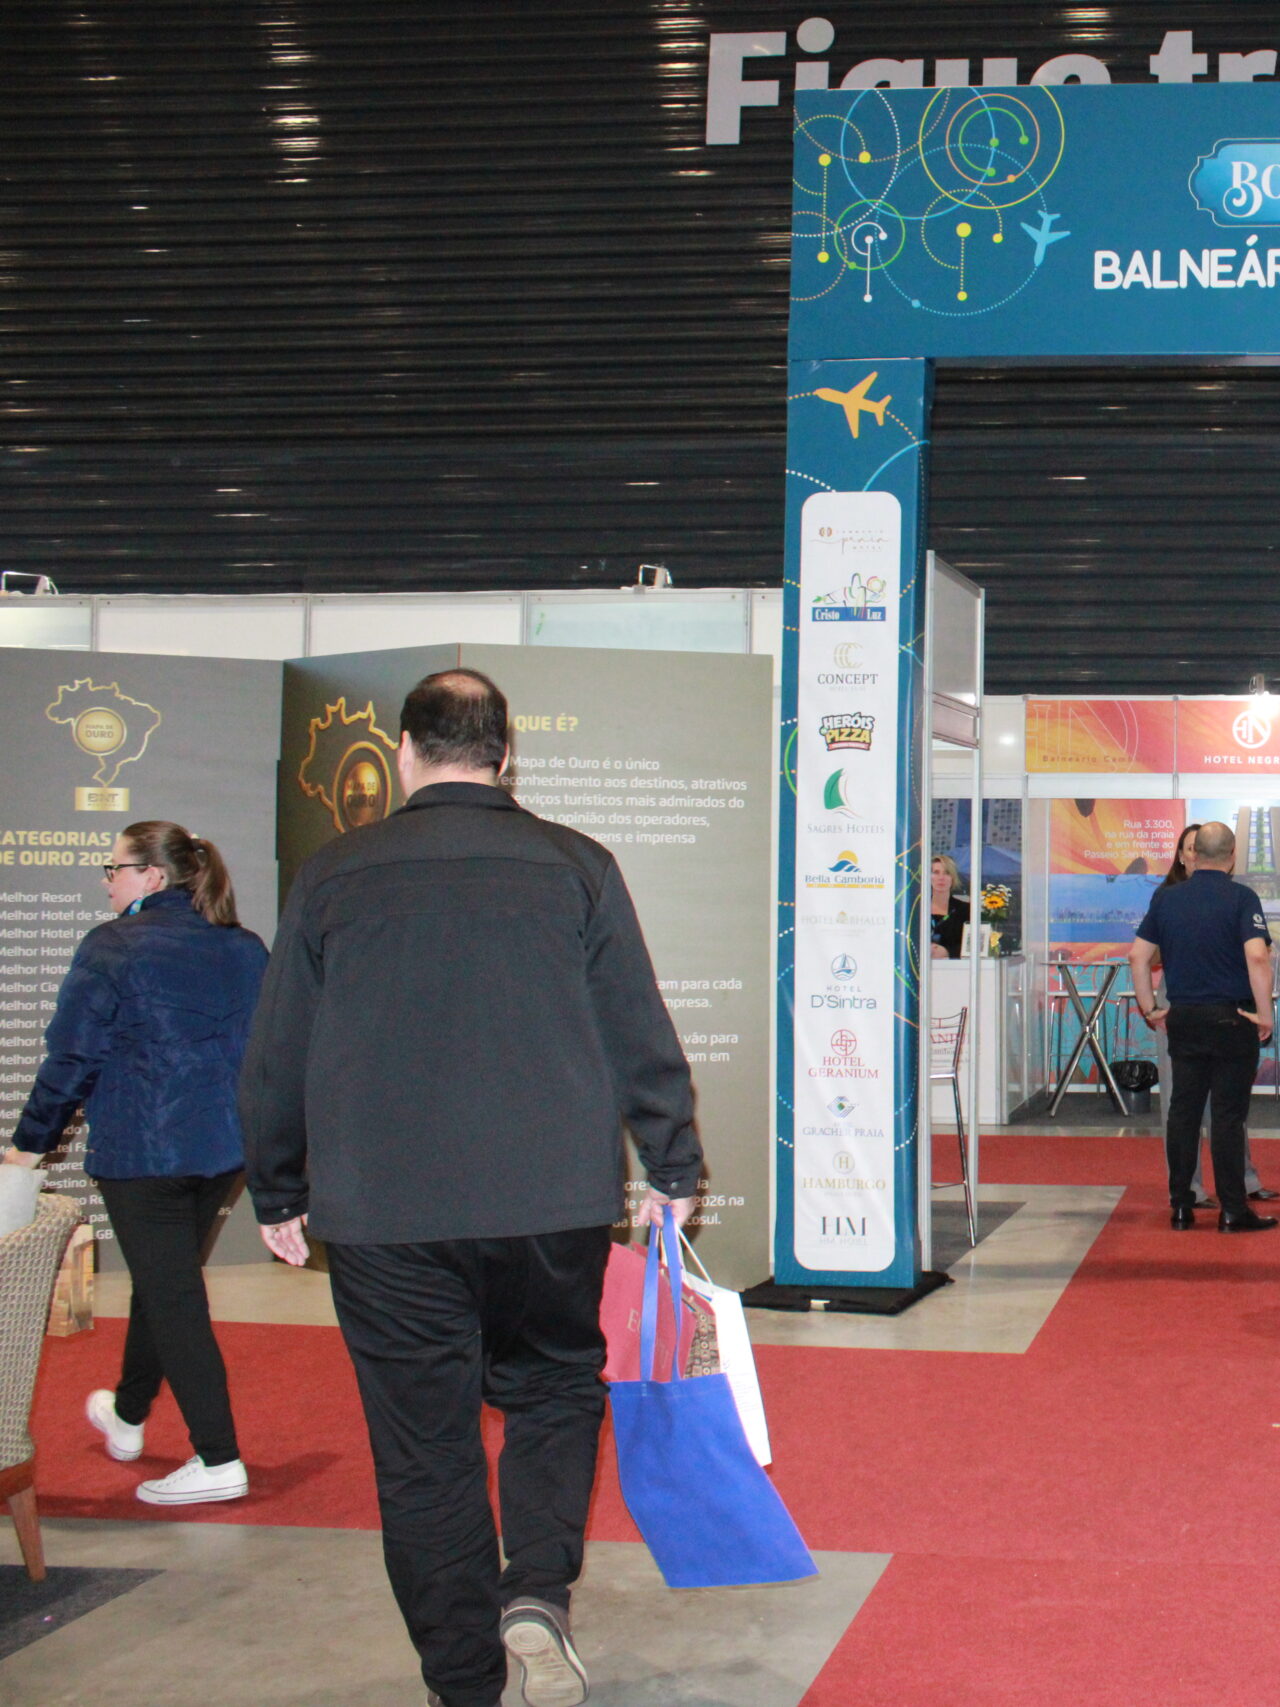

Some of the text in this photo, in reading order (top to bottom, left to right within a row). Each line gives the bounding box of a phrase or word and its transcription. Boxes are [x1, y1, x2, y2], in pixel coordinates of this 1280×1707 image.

[815, 608, 881, 621] Cristo Luz
[817, 673, 878, 685] CONCEPT
[514, 712, 578, 733] QUE É?
[823, 713, 875, 730] HERÓIS
[826, 729, 872, 744] PIZZA
[509, 756, 660, 771] Mapa de Ouro único
[1204, 755, 1243, 765] HOTEL
[604, 777, 747, 791] aos destinos, atrativos
[564, 793, 745, 808] turísticos mais admirados do
[559, 813, 710, 828] opinião dos operadores,
[1124, 820, 1142, 829] Rua
[636, 832, 696, 845] imprensa
[1137, 830, 1148, 839] da
[1151, 830, 1174, 841] praia
[1132, 840, 1160, 848] frente
[20, 851, 74, 867] OURO
[805, 874, 830, 884] Bella
[42, 893, 82, 903] Resort
[41, 911, 92, 921] Hotel de
[41, 929, 74, 939] Hotel
[681, 978, 742, 992] para cada
[811, 994, 877, 1009] D'Sintra
[823, 1056, 864, 1067] HOTEL
[808, 1067, 879, 1079] GERANIUM
[803, 1177, 887, 1190] HAMBURGO
